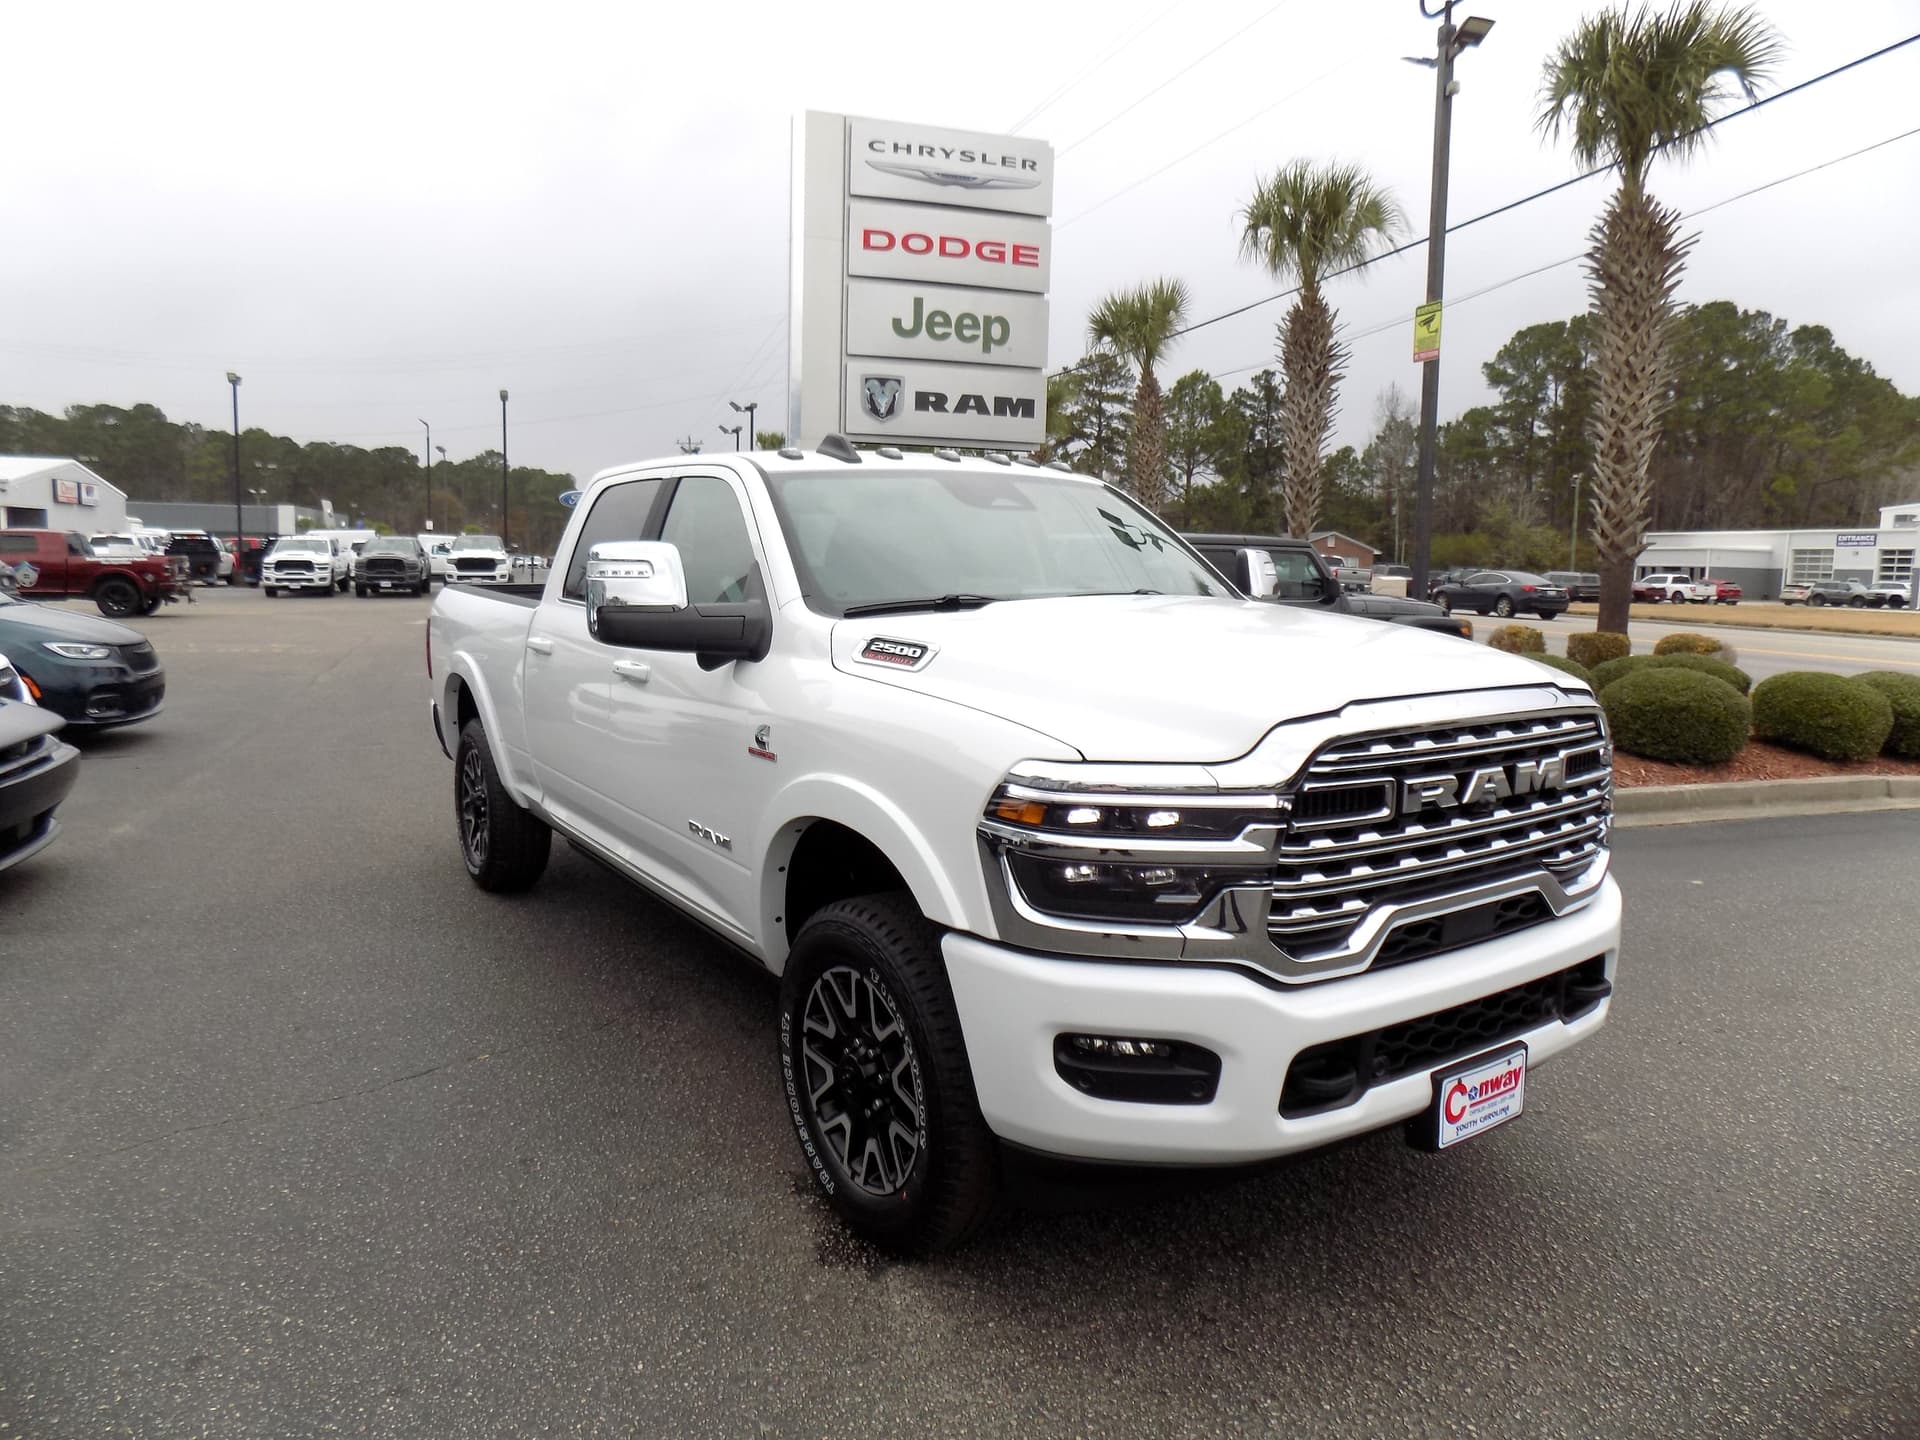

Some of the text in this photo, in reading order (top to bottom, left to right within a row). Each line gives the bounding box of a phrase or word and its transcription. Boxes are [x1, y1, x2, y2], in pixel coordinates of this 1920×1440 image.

[868, 140, 1038, 172] CHRYSLER
[862, 228, 1040, 268] DODGE
[892, 296, 1011, 354] Jeep
[914, 391, 1036, 419] RAM
[870, 641, 922, 657] 2500
[1403, 757, 1563, 814] RAM
[688, 819, 733, 851] RAM
[782, 1053, 835, 1196] TRANSFORCE
